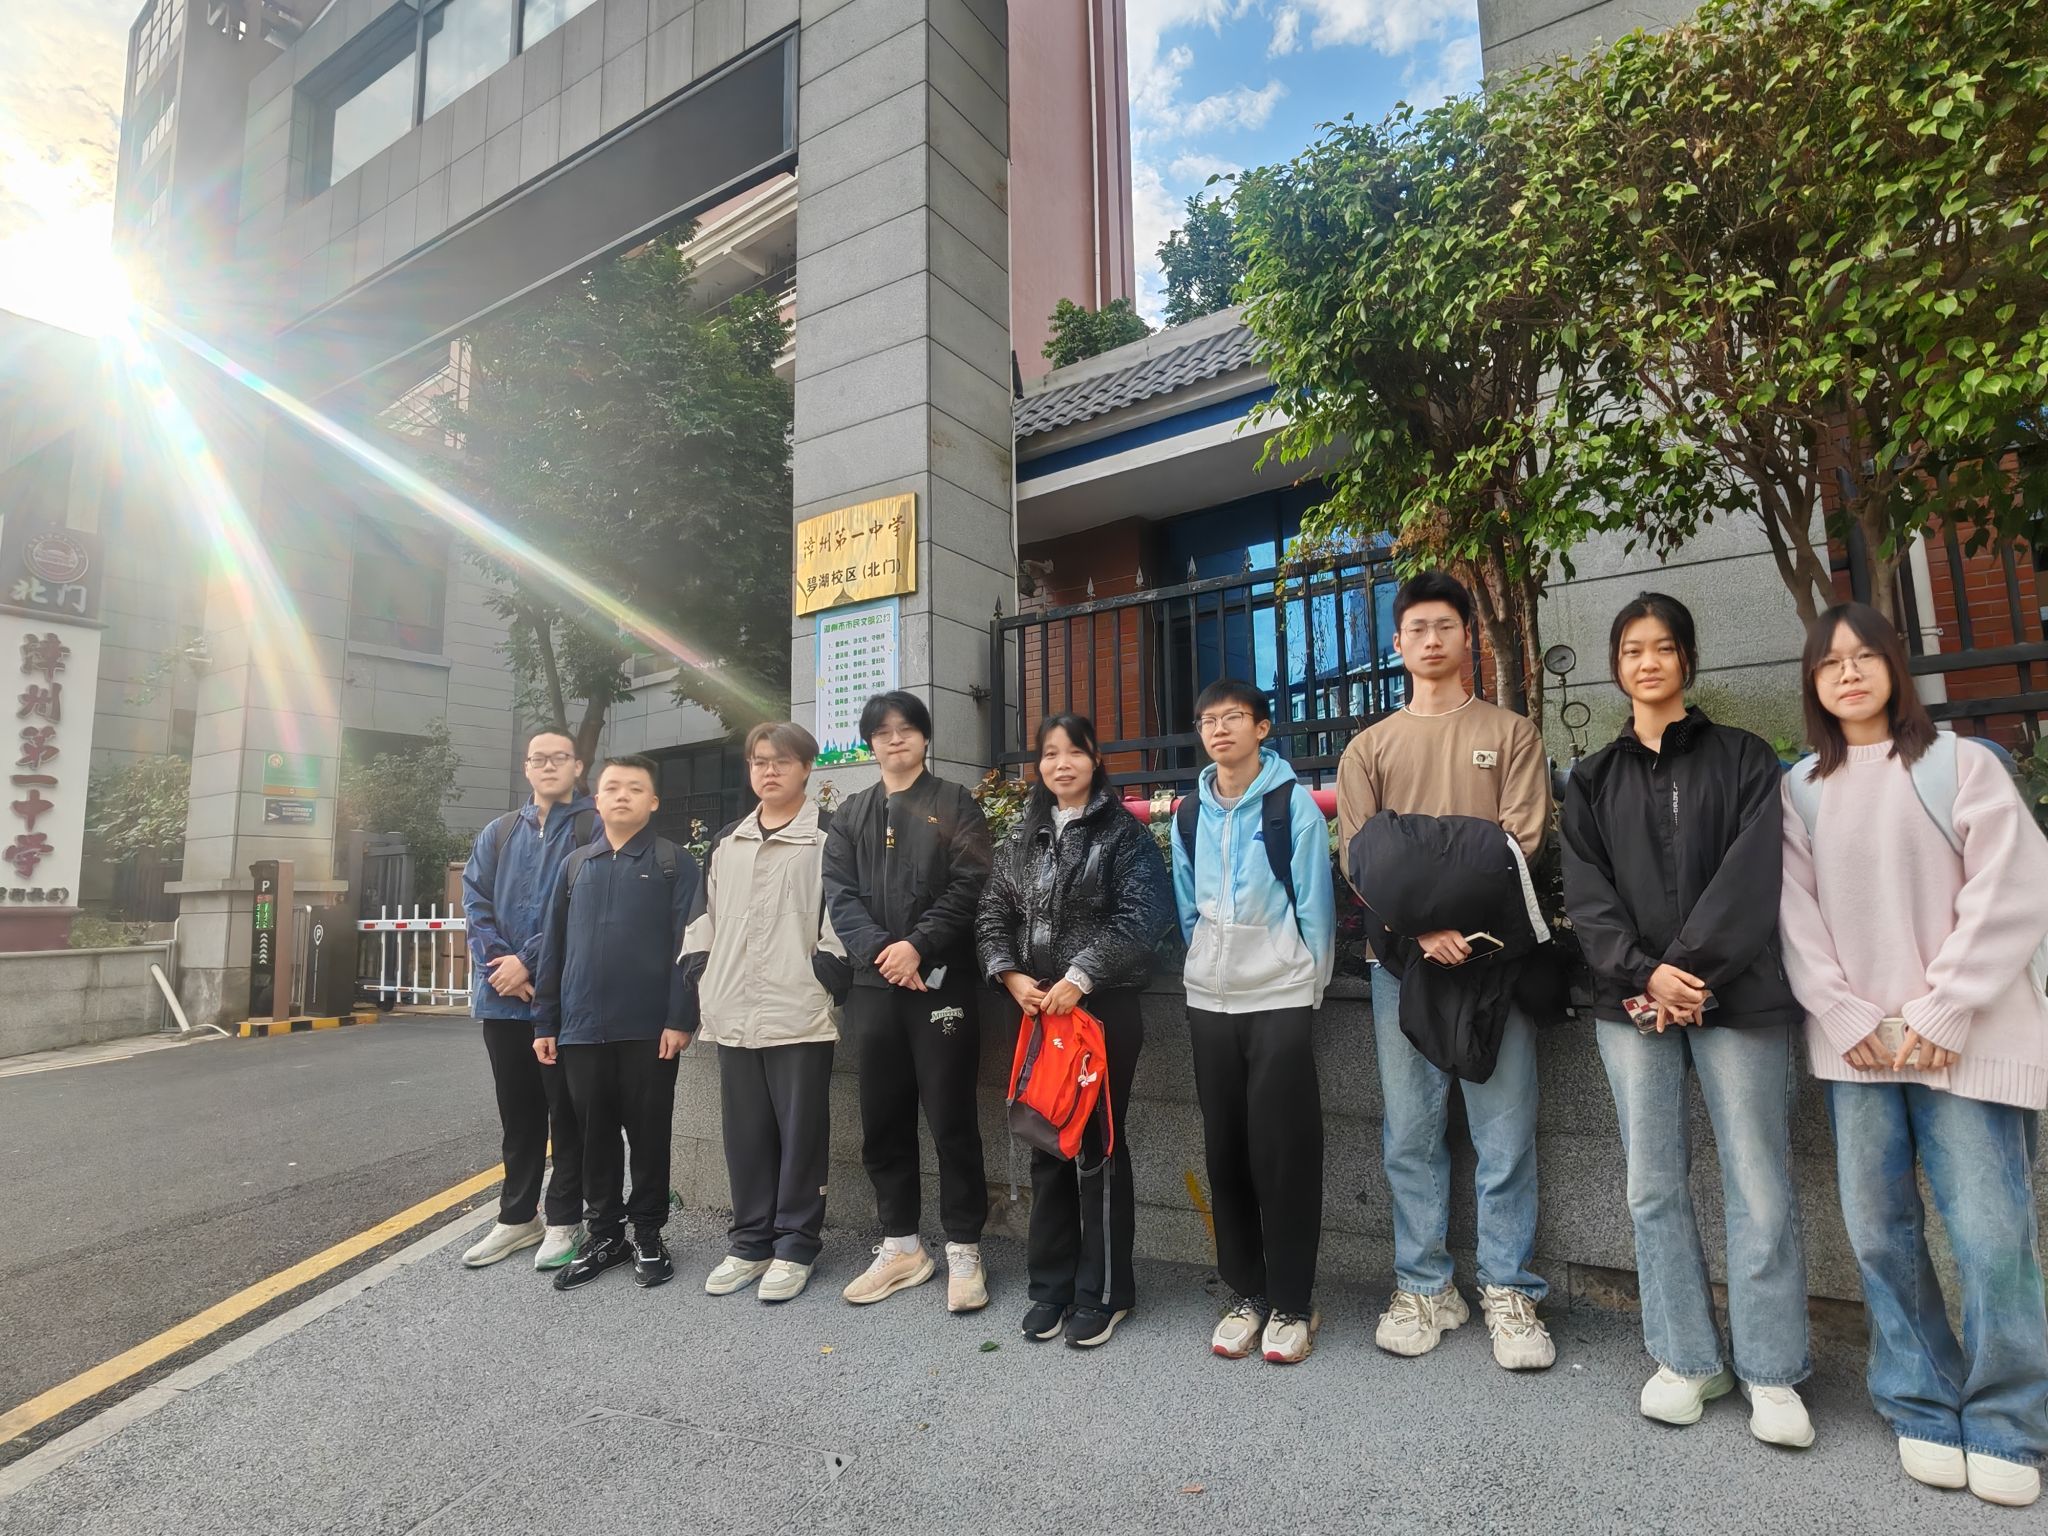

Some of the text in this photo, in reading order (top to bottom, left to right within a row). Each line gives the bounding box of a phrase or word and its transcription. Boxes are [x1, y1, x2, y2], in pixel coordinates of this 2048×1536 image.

[803, 515, 906, 560] 漳州第一中学
[10, 577, 87, 613] 北门
[262, 880, 270, 892] P
